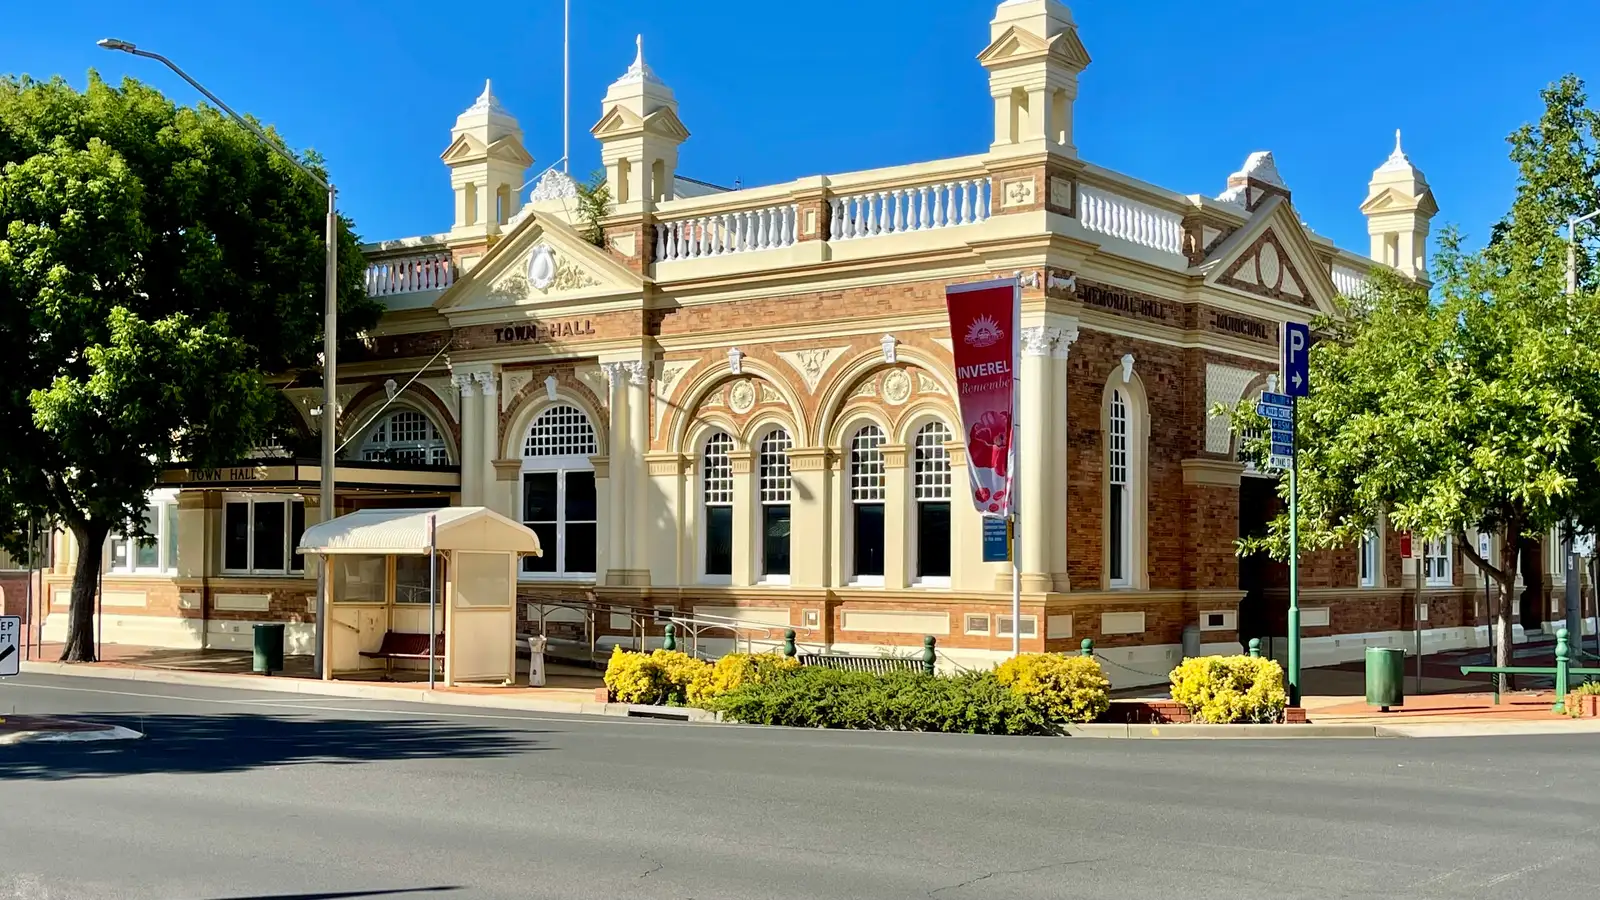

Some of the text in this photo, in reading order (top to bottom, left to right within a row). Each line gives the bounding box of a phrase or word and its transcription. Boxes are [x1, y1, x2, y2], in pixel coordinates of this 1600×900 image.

[1083, 285, 1166, 320] MEMORIAL HALL
[494, 320, 595, 344] TOWN HALL
[1216, 313, 1268, 339] MUNICIPAL
[1290, 329, 1305, 363] P
[958, 360, 1010, 379] INVEREL
[962, 376, 1011, 395] Remembe
[191, 467, 257, 481] TOWN HALL
[0, 621, 14, 631] EP
[0, 633, 12, 643] FT
